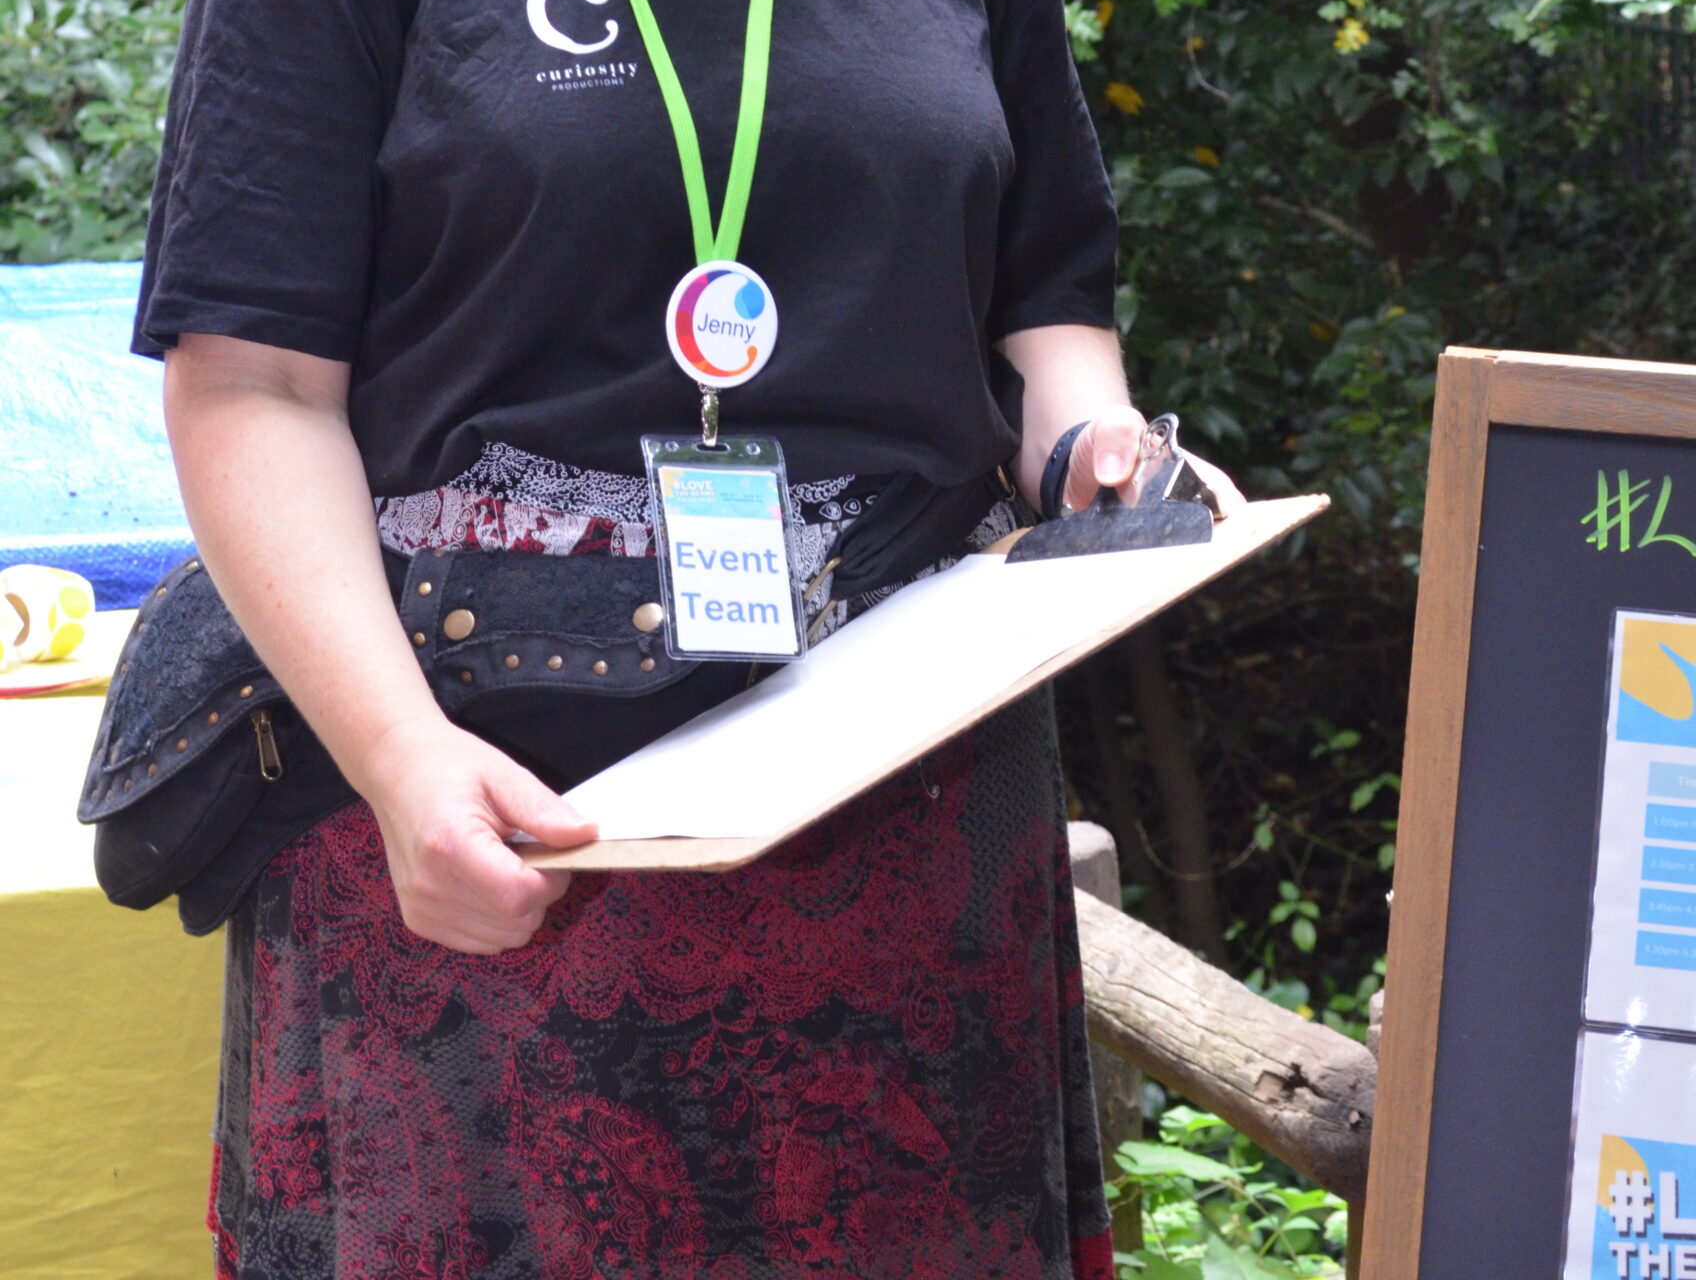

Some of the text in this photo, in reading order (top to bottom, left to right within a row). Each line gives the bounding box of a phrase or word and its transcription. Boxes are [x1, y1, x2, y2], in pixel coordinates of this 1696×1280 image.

[536, 62, 637, 83] curiosity
[551, 77, 625, 92] PRODUCTIONS
[697, 313, 756, 344] Jenny
[675, 542, 780, 574] Event
[680, 592, 780, 624] Team
